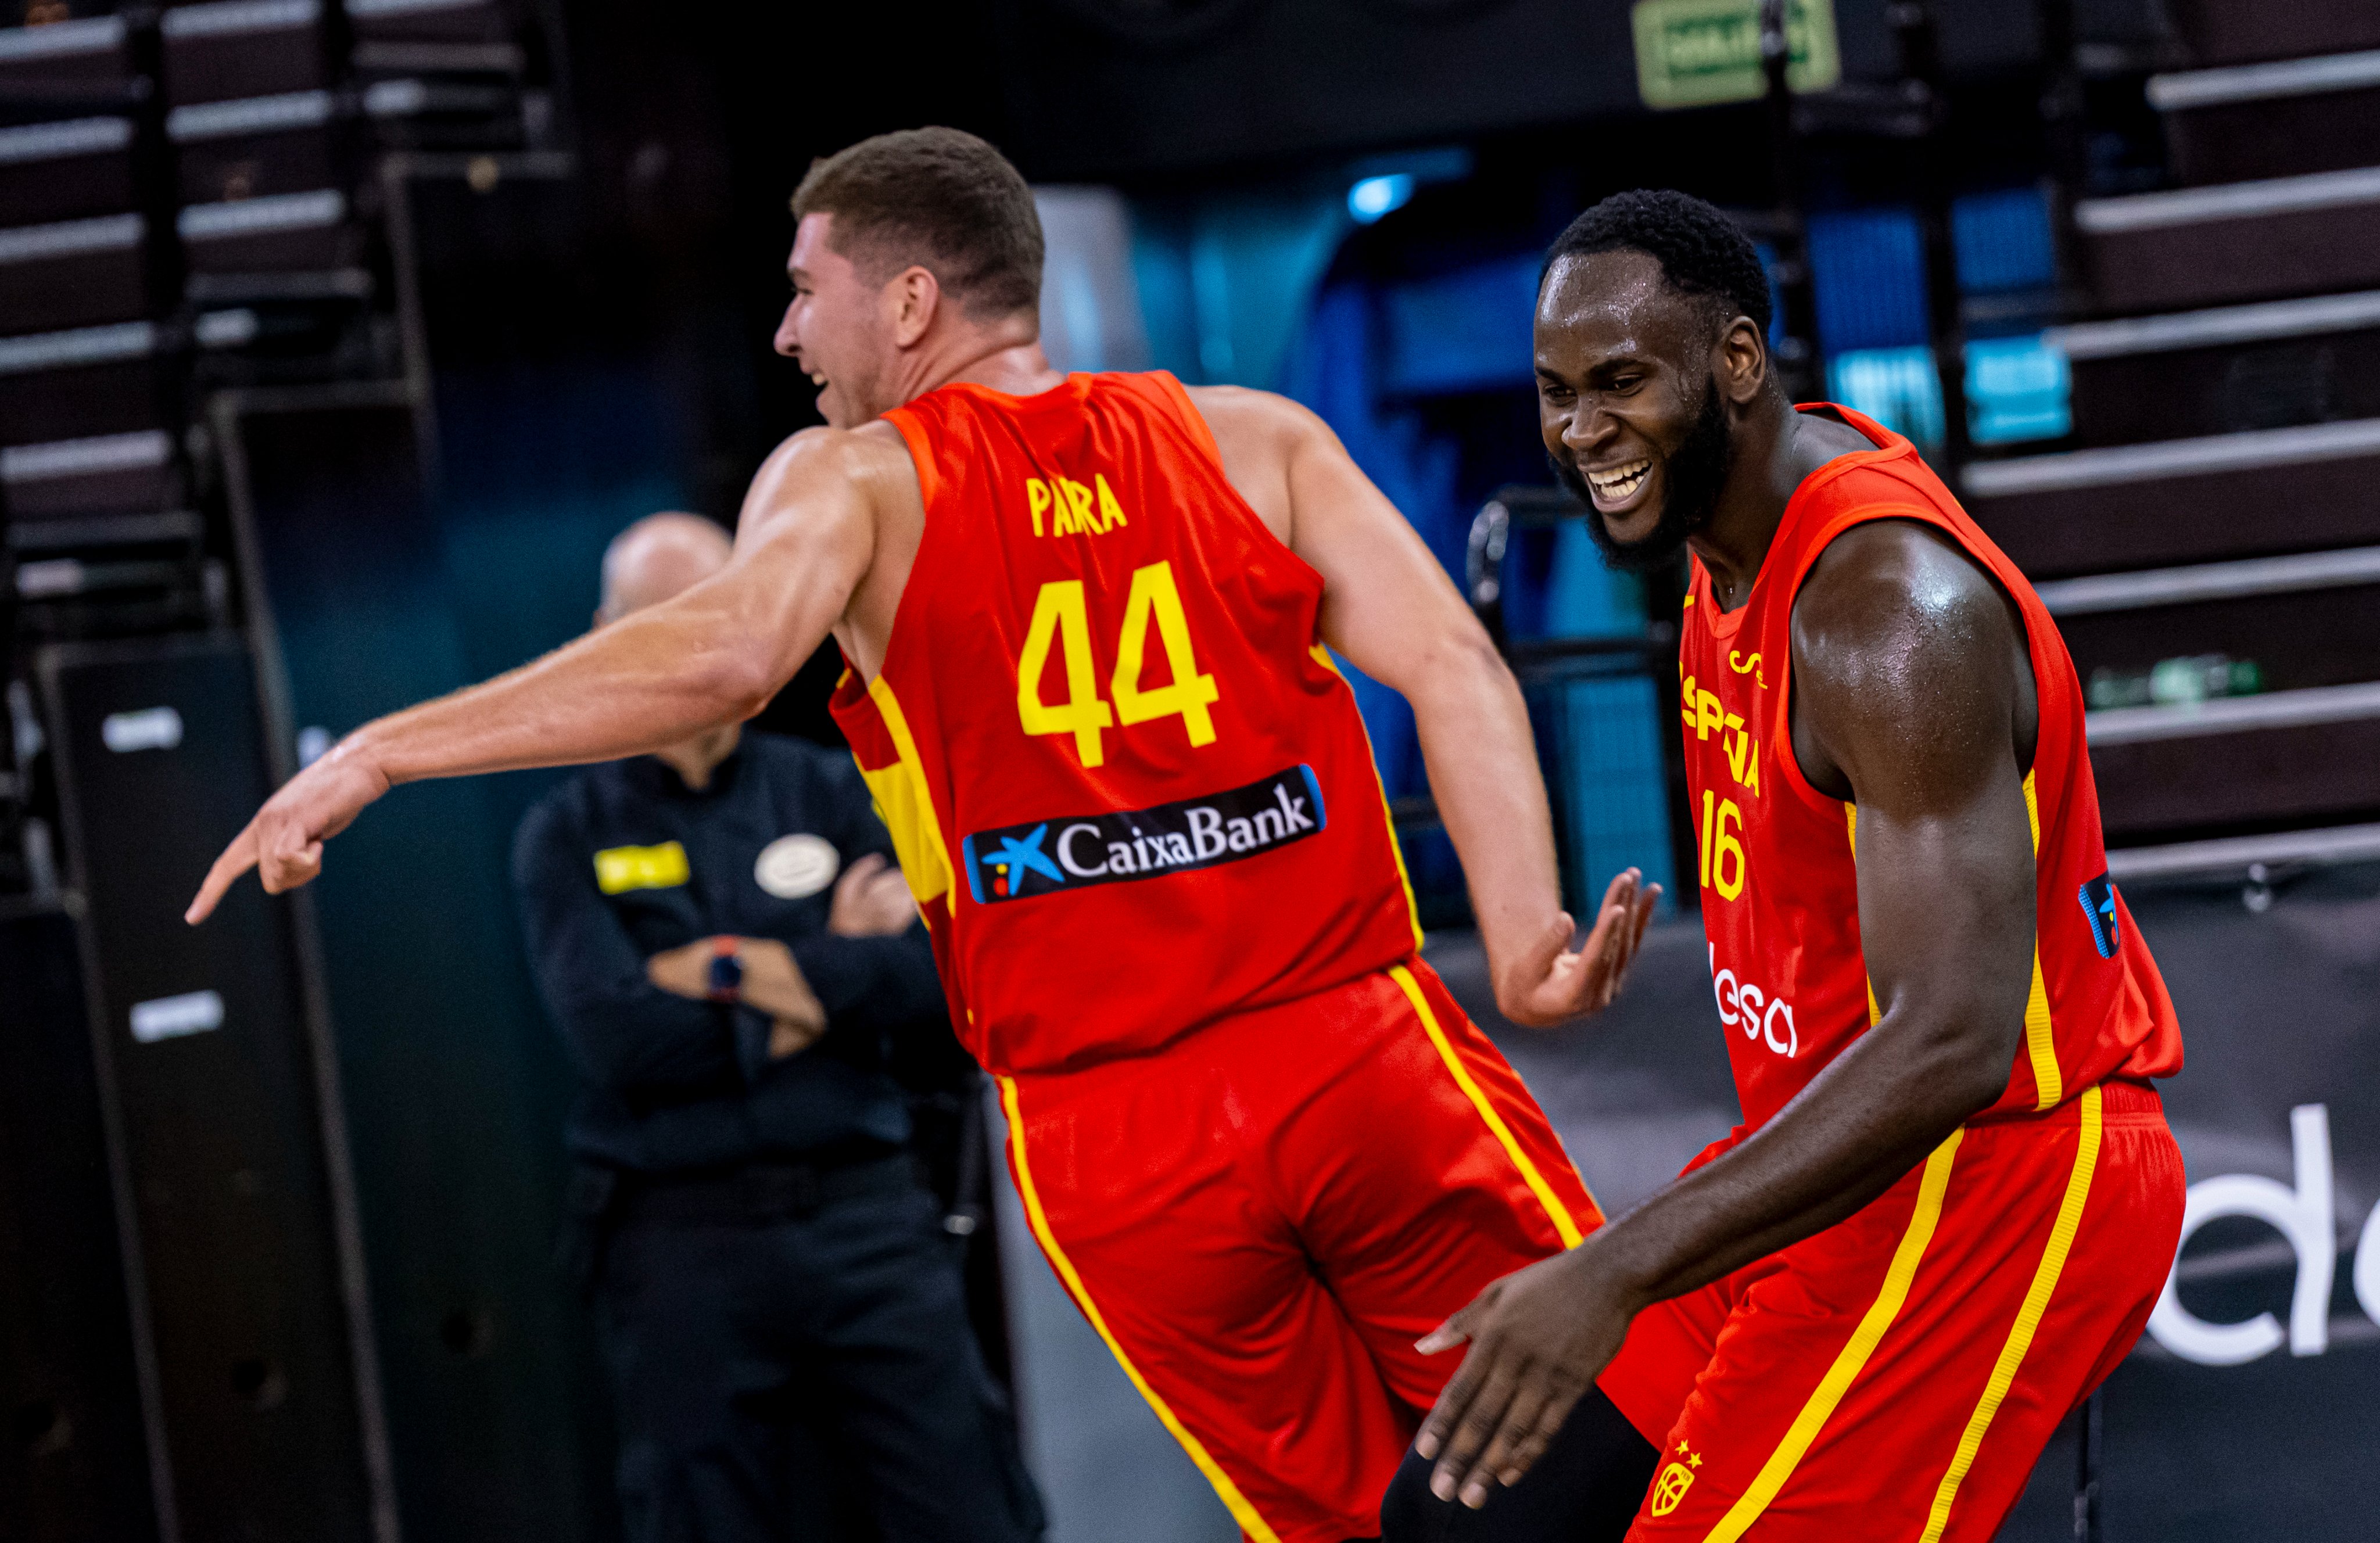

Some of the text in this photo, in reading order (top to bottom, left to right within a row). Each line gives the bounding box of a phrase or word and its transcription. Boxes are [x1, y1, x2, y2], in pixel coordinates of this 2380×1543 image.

[1017, 559, 1219, 767] 44
[1056, 783, 1314, 878] CaixaBank
[1701, 789, 1745, 902] 16
[1709, 941, 1798, 1058] esa
